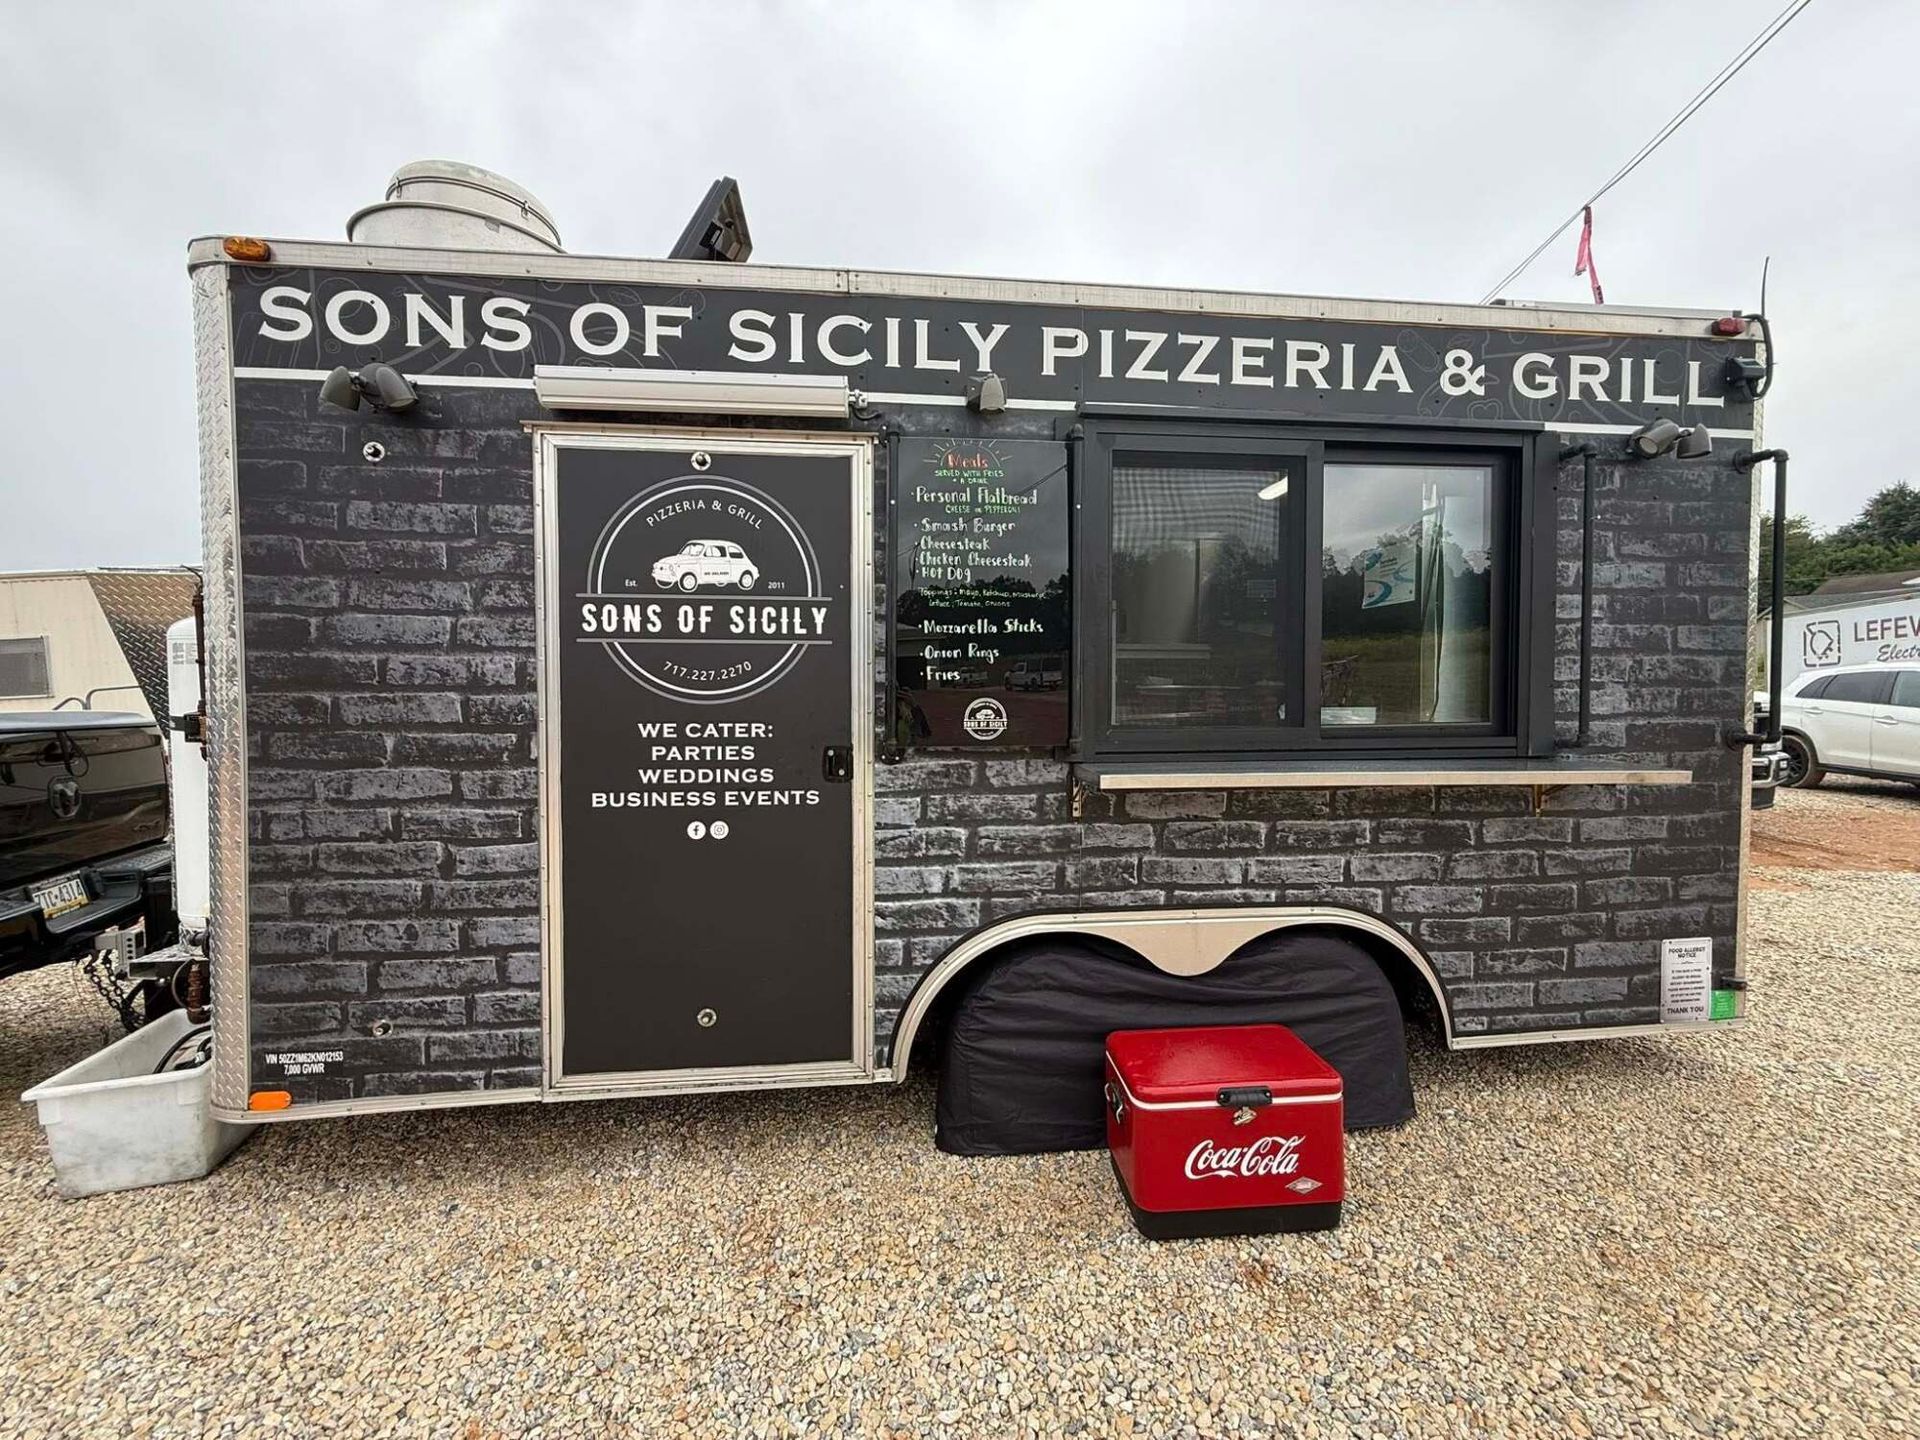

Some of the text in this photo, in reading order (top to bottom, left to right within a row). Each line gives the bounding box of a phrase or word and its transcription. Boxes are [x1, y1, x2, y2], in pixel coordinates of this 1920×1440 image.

[258, 286, 1725, 408] SONS OF SICILY PIZZERIA & GRILL
[948, 453, 989, 467] Meals
[916, 486, 1038, 505] Personal Flatbread
[646, 500, 762, 529] PIZZERIA & GRILL
[920, 517, 1016, 537] Smash Burger
[920, 535, 991, 551] Cheesesteak
[919, 551, 1032, 567] Chicken Cheesesteak
[625, 579, 638, 587] Est.
[768, 581, 785, 589] 2011
[581, 603, 828, 635] SONS OF SICILY
[923, 618, 1044, 634] Mozzarella Sticks
[924, 642, 1000, 664] Onion Rings
[663, 660, 752, 681] 717.227.2270
[926, 665, 961, 681] Fries
[637, 723, 774, 738] WE CATER:
[651, 745, 756, 761] PARTIES
[638, 768, 775, 784] WEDDINGS
[591, 790, 820, 808] BUSINESS EVENTS
[265, 1053, 278, 1064] VIN
[302, 1063, 325, 1074] GVWR
